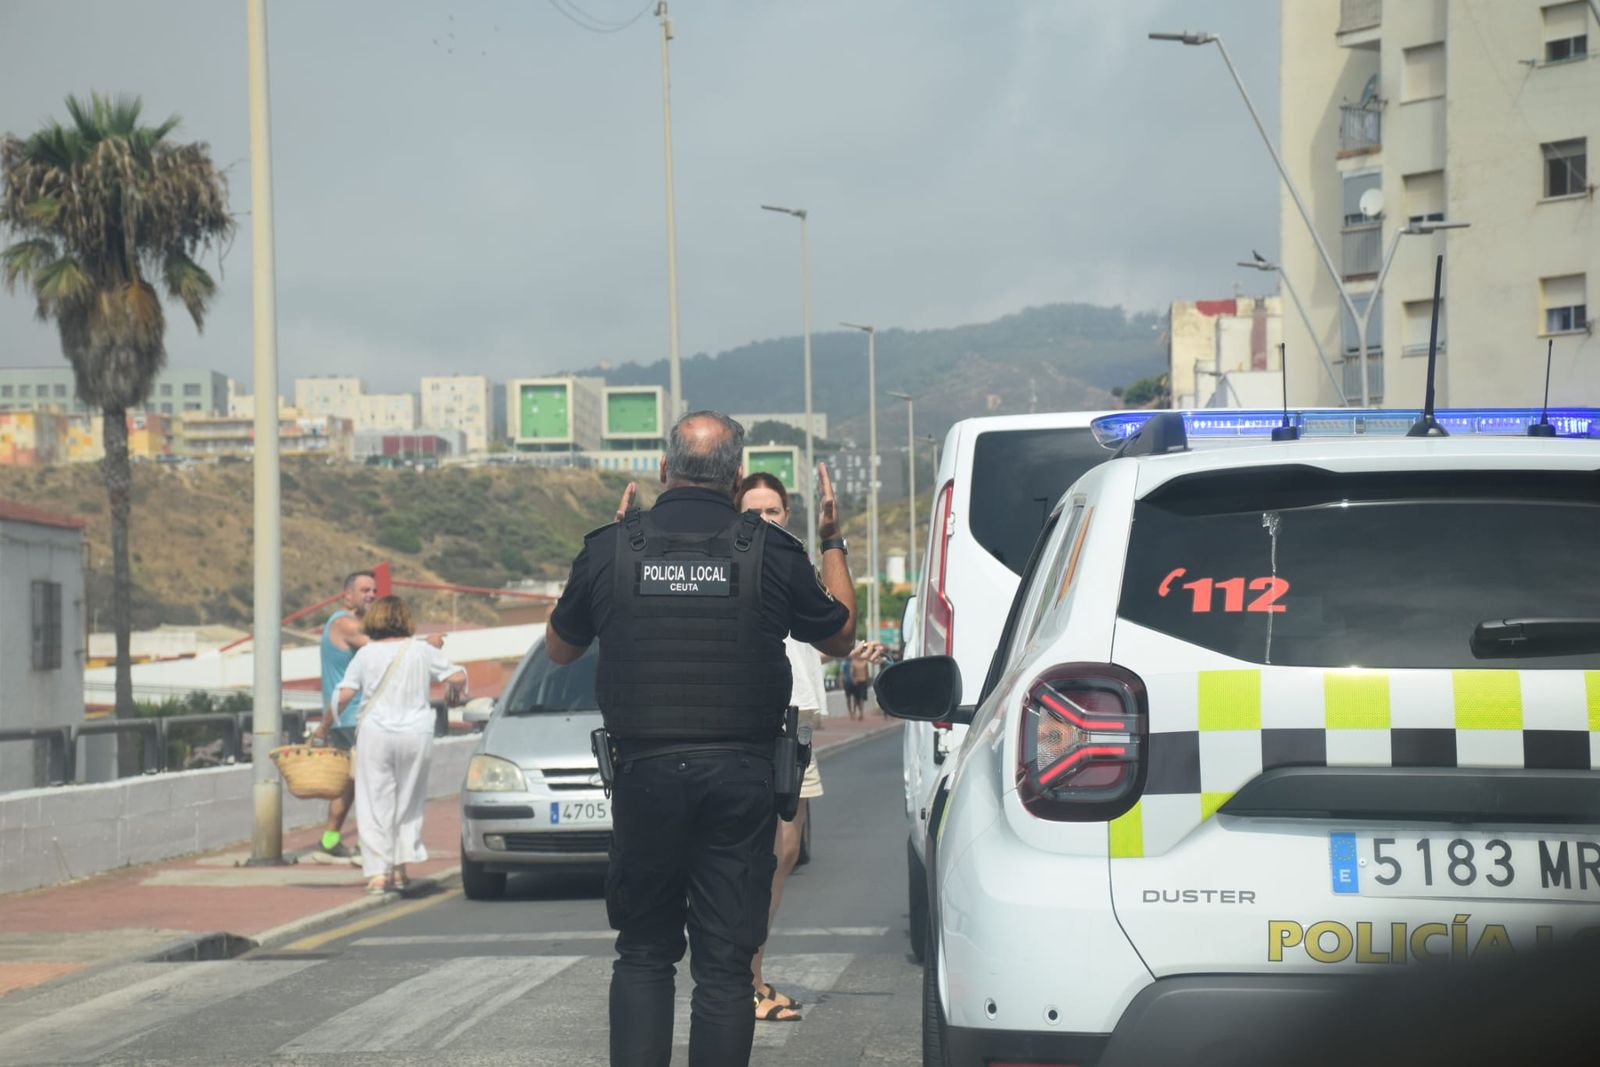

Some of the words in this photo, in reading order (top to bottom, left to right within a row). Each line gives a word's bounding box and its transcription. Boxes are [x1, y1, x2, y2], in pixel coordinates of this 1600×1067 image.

[643, 565, 686, 581] POLICIA
[690, 566, 727, 582] LOCAL
[670, 583, 699, 591] CEUTA
[1183, 577, 1290, 612] 112
[563, 803, 606, 819] 4705
[1373, 838, 1515, 887] 5183
[1538, 840, 1600, 889] MR
[1340, 869, 1351, 882] E
[1142, 889, 1256, 904] DUSTER
[1268, 914, 1515, 965] POLICÍA
